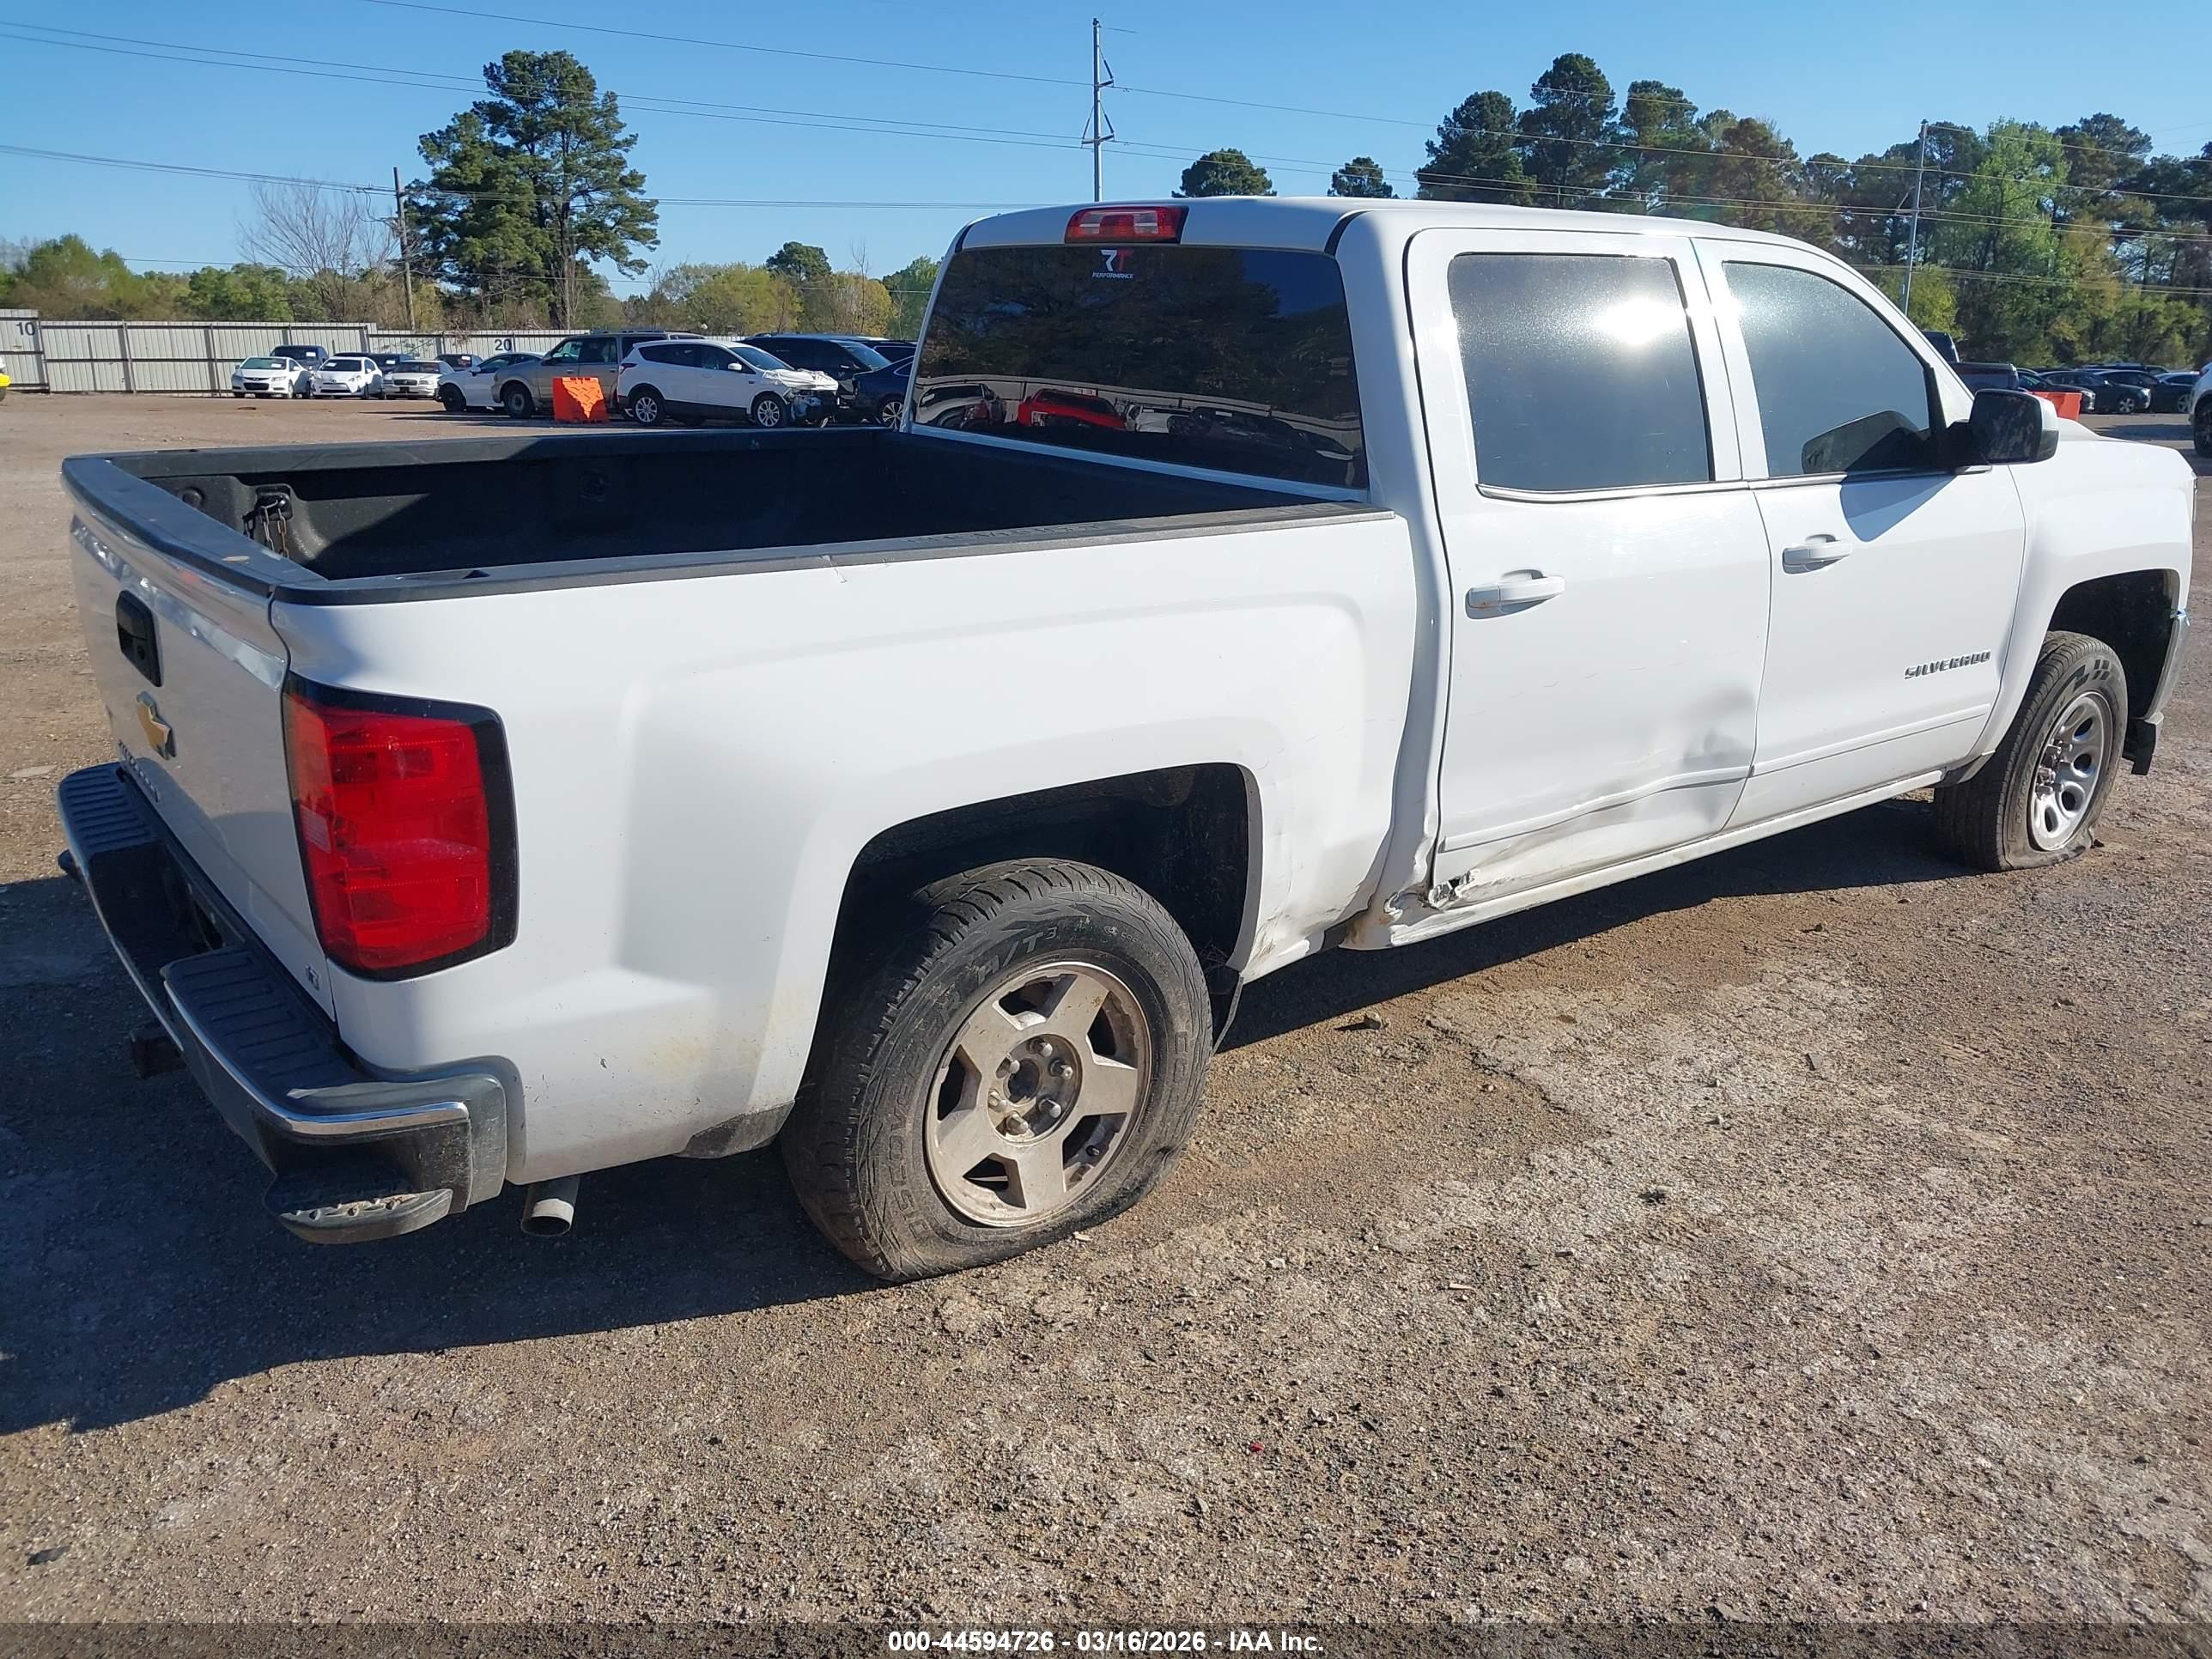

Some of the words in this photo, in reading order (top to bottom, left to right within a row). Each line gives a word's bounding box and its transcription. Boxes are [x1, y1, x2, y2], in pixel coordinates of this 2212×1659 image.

[15, 321, 36, 336] 10
[494, 338, 513, 351] 20
[1904, 650, 1991, 680] SILVERADO
